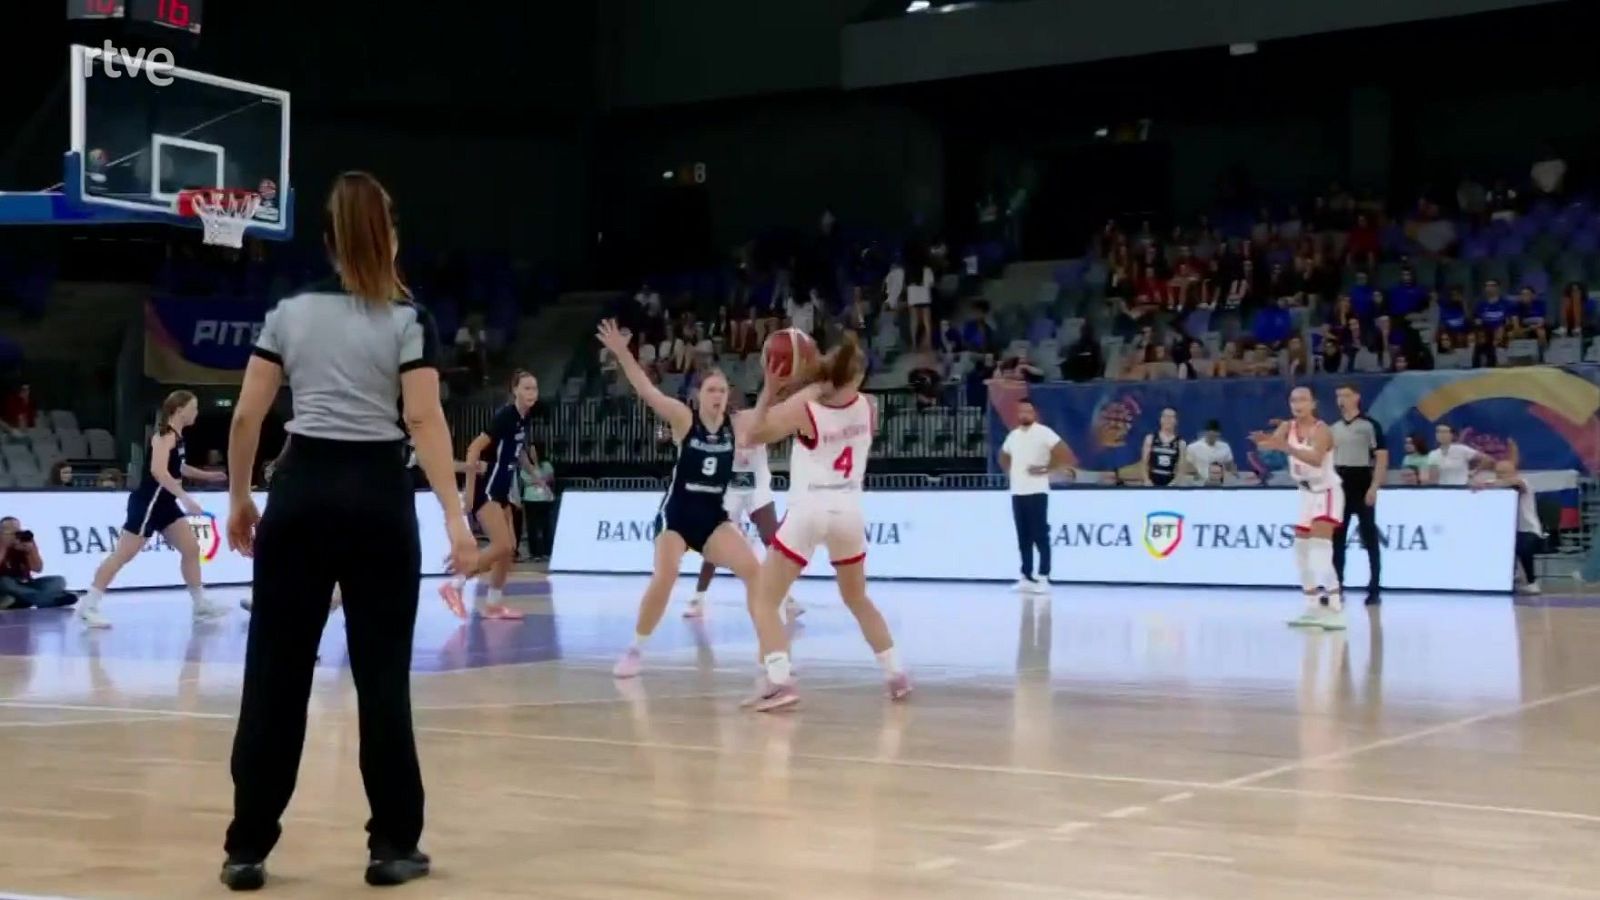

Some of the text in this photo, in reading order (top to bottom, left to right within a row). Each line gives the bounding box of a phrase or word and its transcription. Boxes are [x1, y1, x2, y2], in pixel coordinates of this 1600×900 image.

[694, 162, 707, 184] 8
[702, 456, 718, 476] 9
[832, 446, 853, 479] 4
[596, 520, 658, 541] BANC
[1047, 523, 1133, 547] ANCA
[1151, 523, 1177, 538] BT
